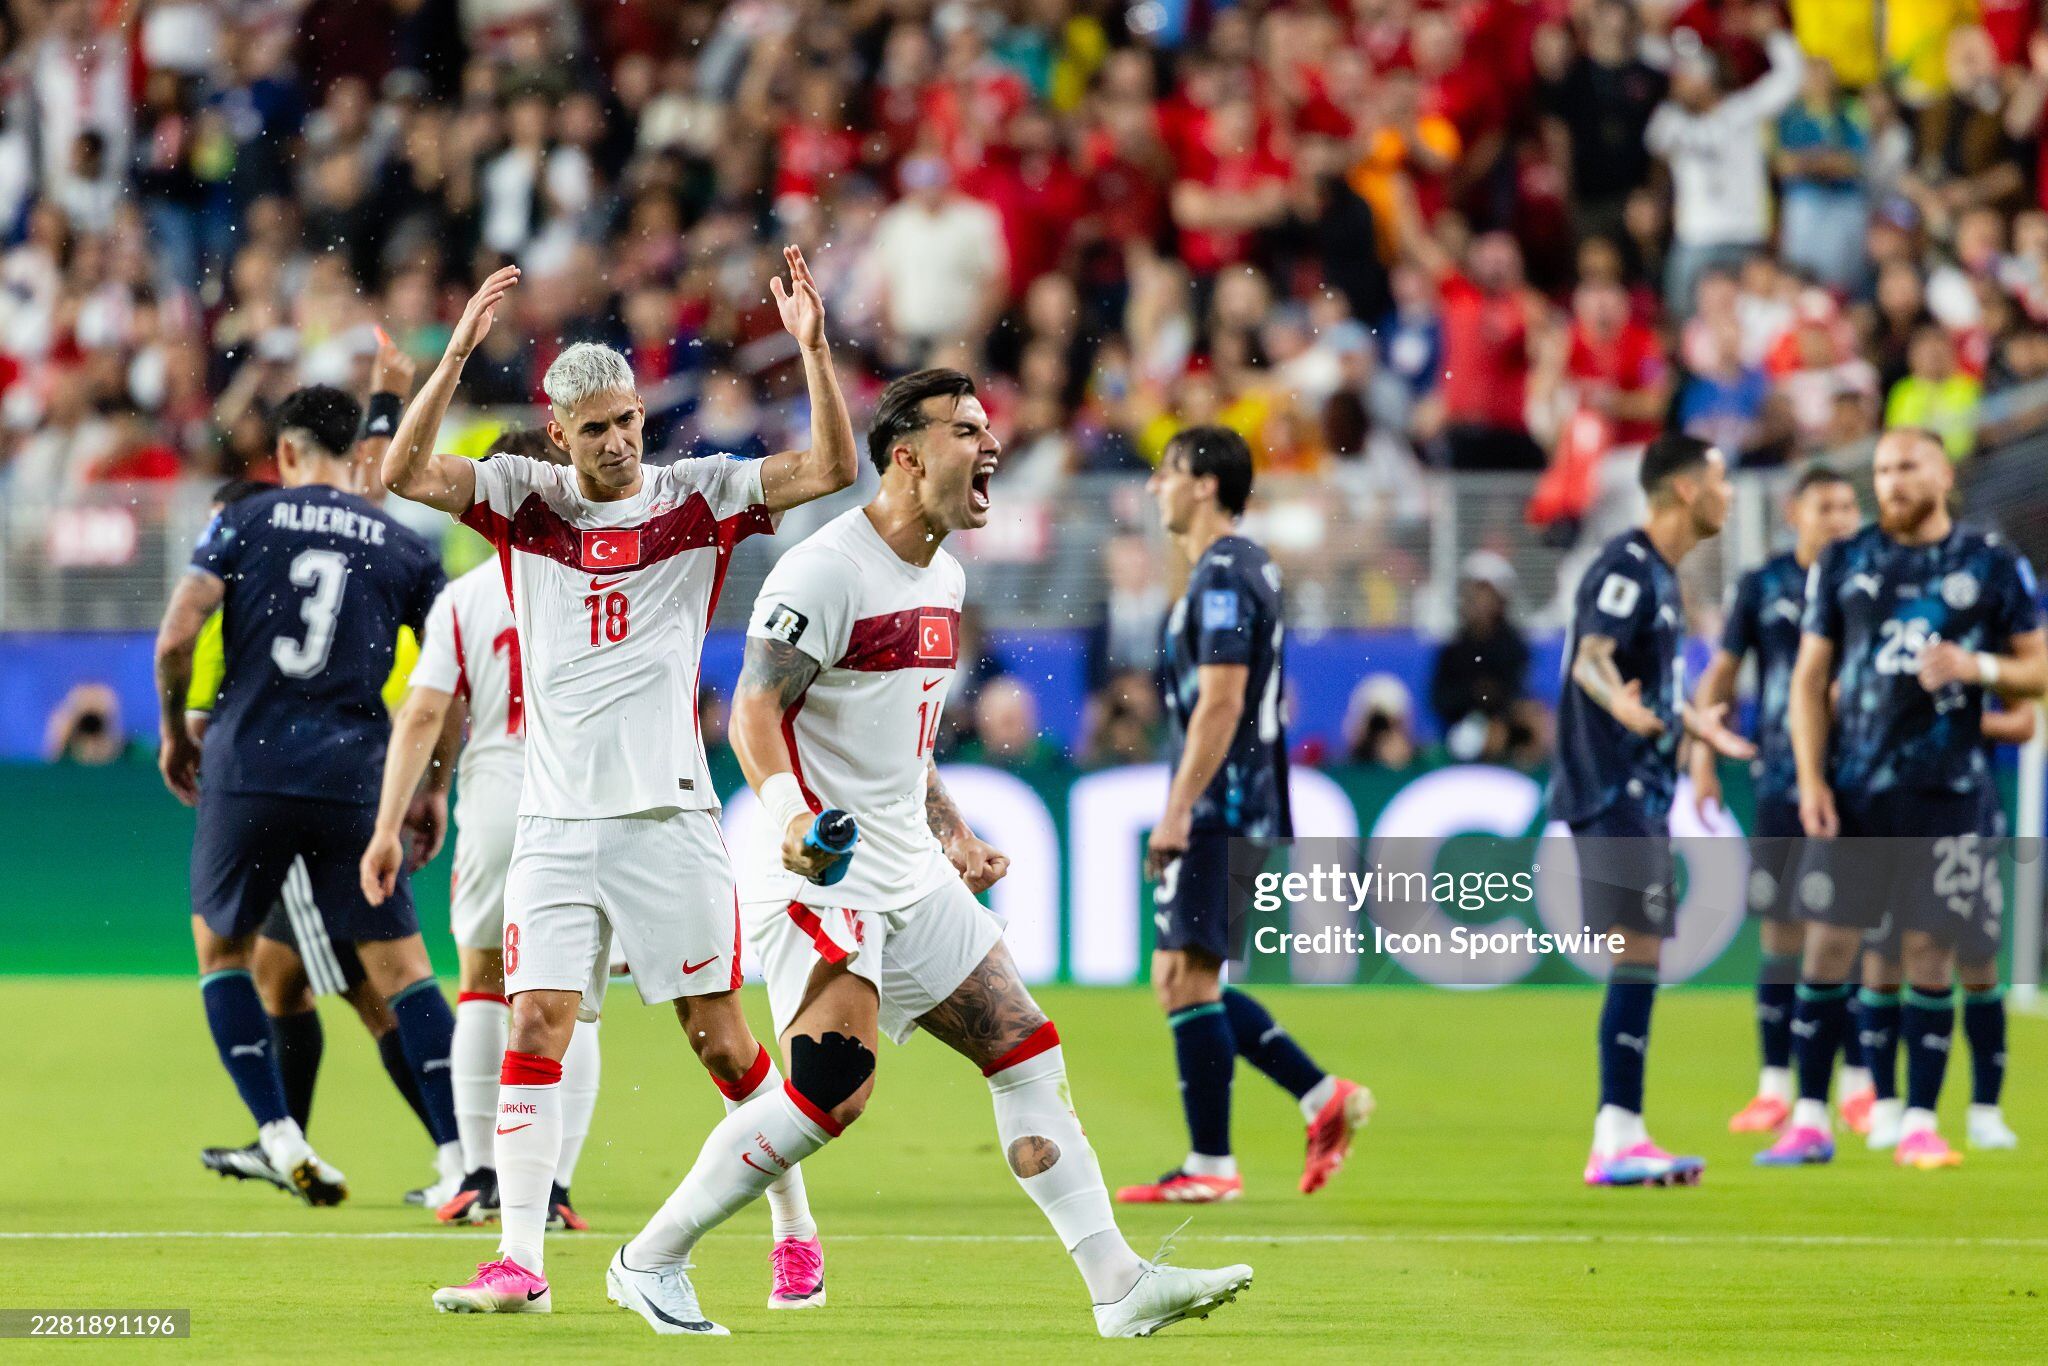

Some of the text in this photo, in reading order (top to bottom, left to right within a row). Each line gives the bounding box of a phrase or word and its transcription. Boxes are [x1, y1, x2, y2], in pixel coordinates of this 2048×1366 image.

[273, 502, 387, 546] ALDERETE
[270, 548, 350, 680] 3
[584, 591, 631, 647] 18
[1932, 832, 1981, 897] 25
[499, 1101, 537, 1114] ÜRKİYE
